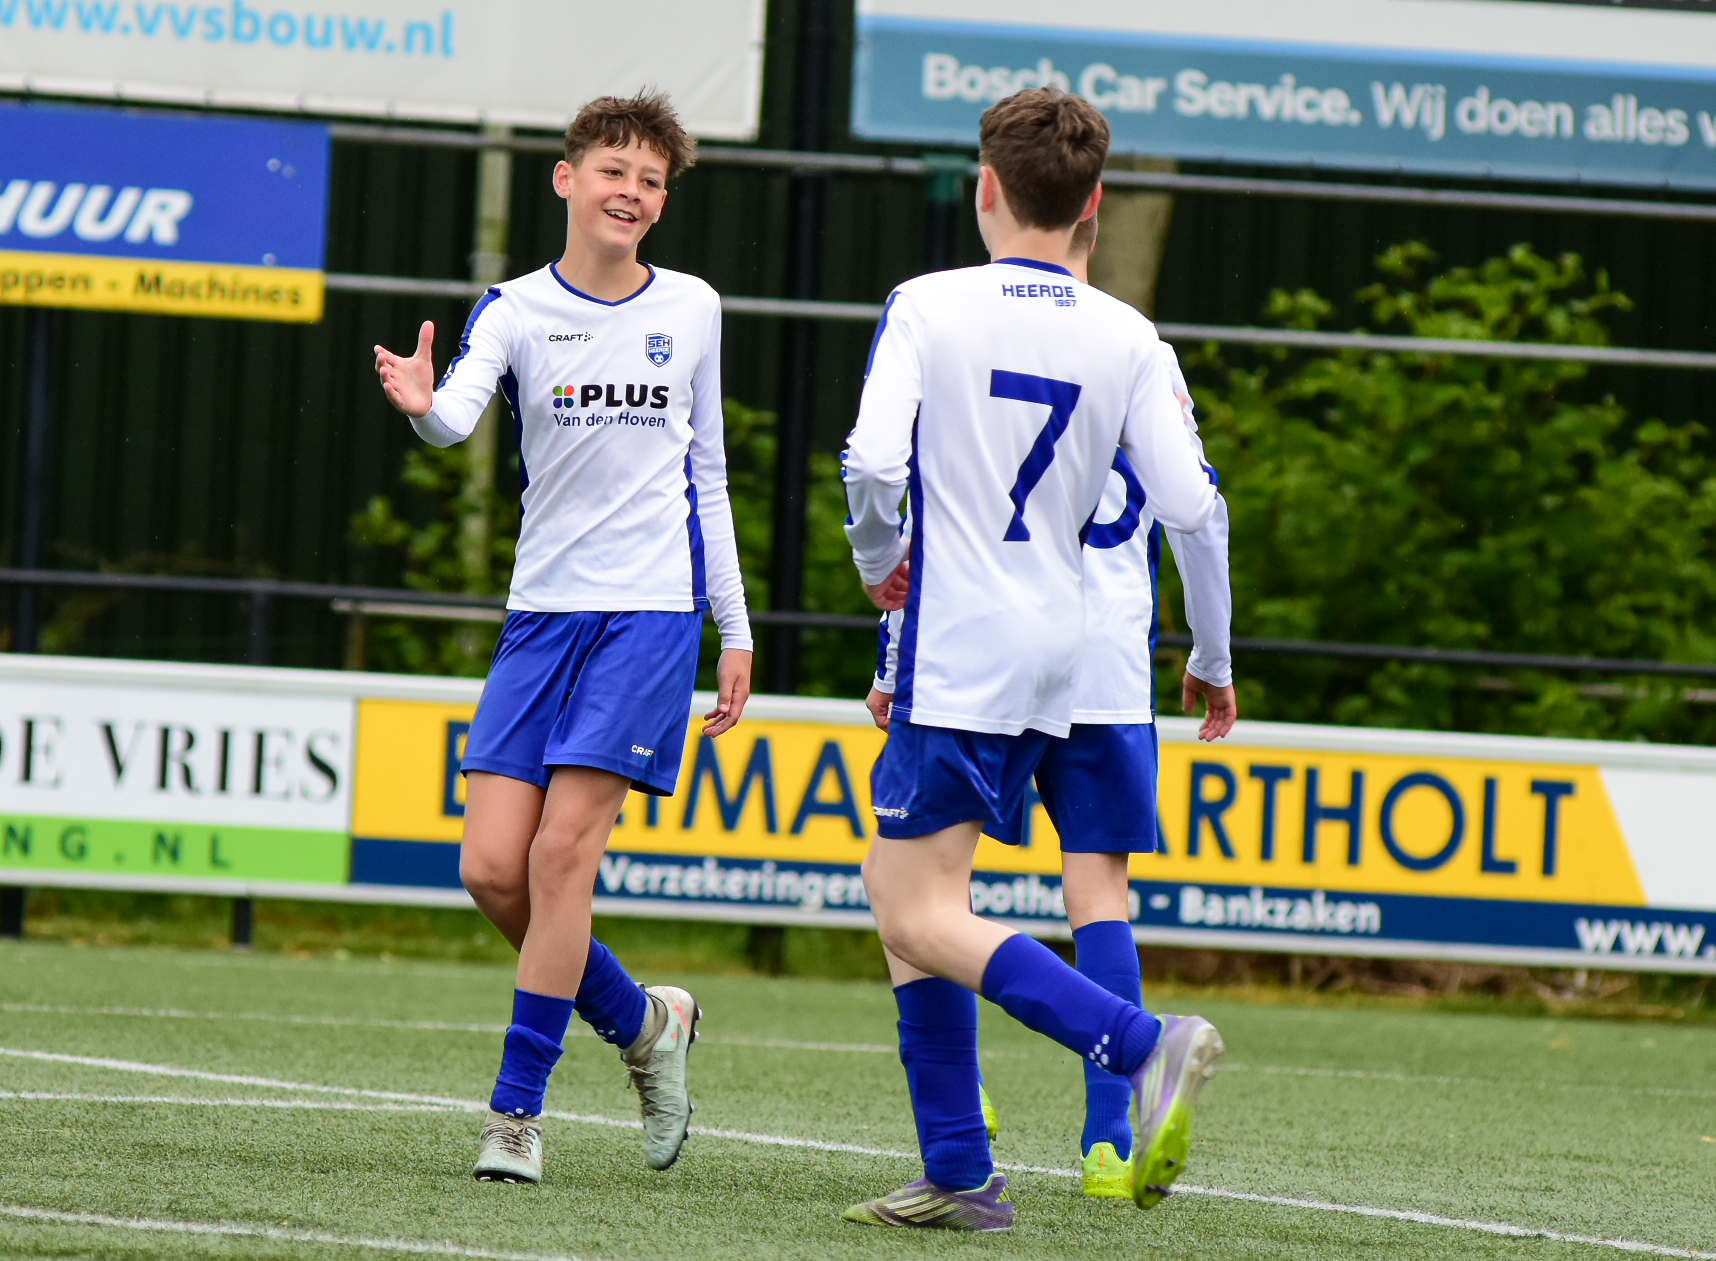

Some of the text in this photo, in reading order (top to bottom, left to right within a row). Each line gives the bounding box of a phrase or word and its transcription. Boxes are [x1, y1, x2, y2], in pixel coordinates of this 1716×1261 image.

[1079, 62, 1168, 113] Car
[1174, 69, 1362, 127] Service.
[1370, 80, 1447, 142] Wij
[1455, 84, 1574, 139] doen
[1583, 92, 1690, 147] alles
[134, 269, 303, 306] Machines
[1001, 283, 1076, 298] HEERDE
[1054, 299, 1077, 307] 1957
[549, 334, 583, 342] CRAFT
[648, 339, 670, 347] SEH
[580, 384, 670, 410] PLUS
[553, 412, 666, 428] Van den Hoven
[989, 369, 1082, 542] 7
[97, 719, 341, 802] VRIES
[599, 855, 870, 913] Verzekeringen
[1178, 885, 1382, 934] Bankzaken
